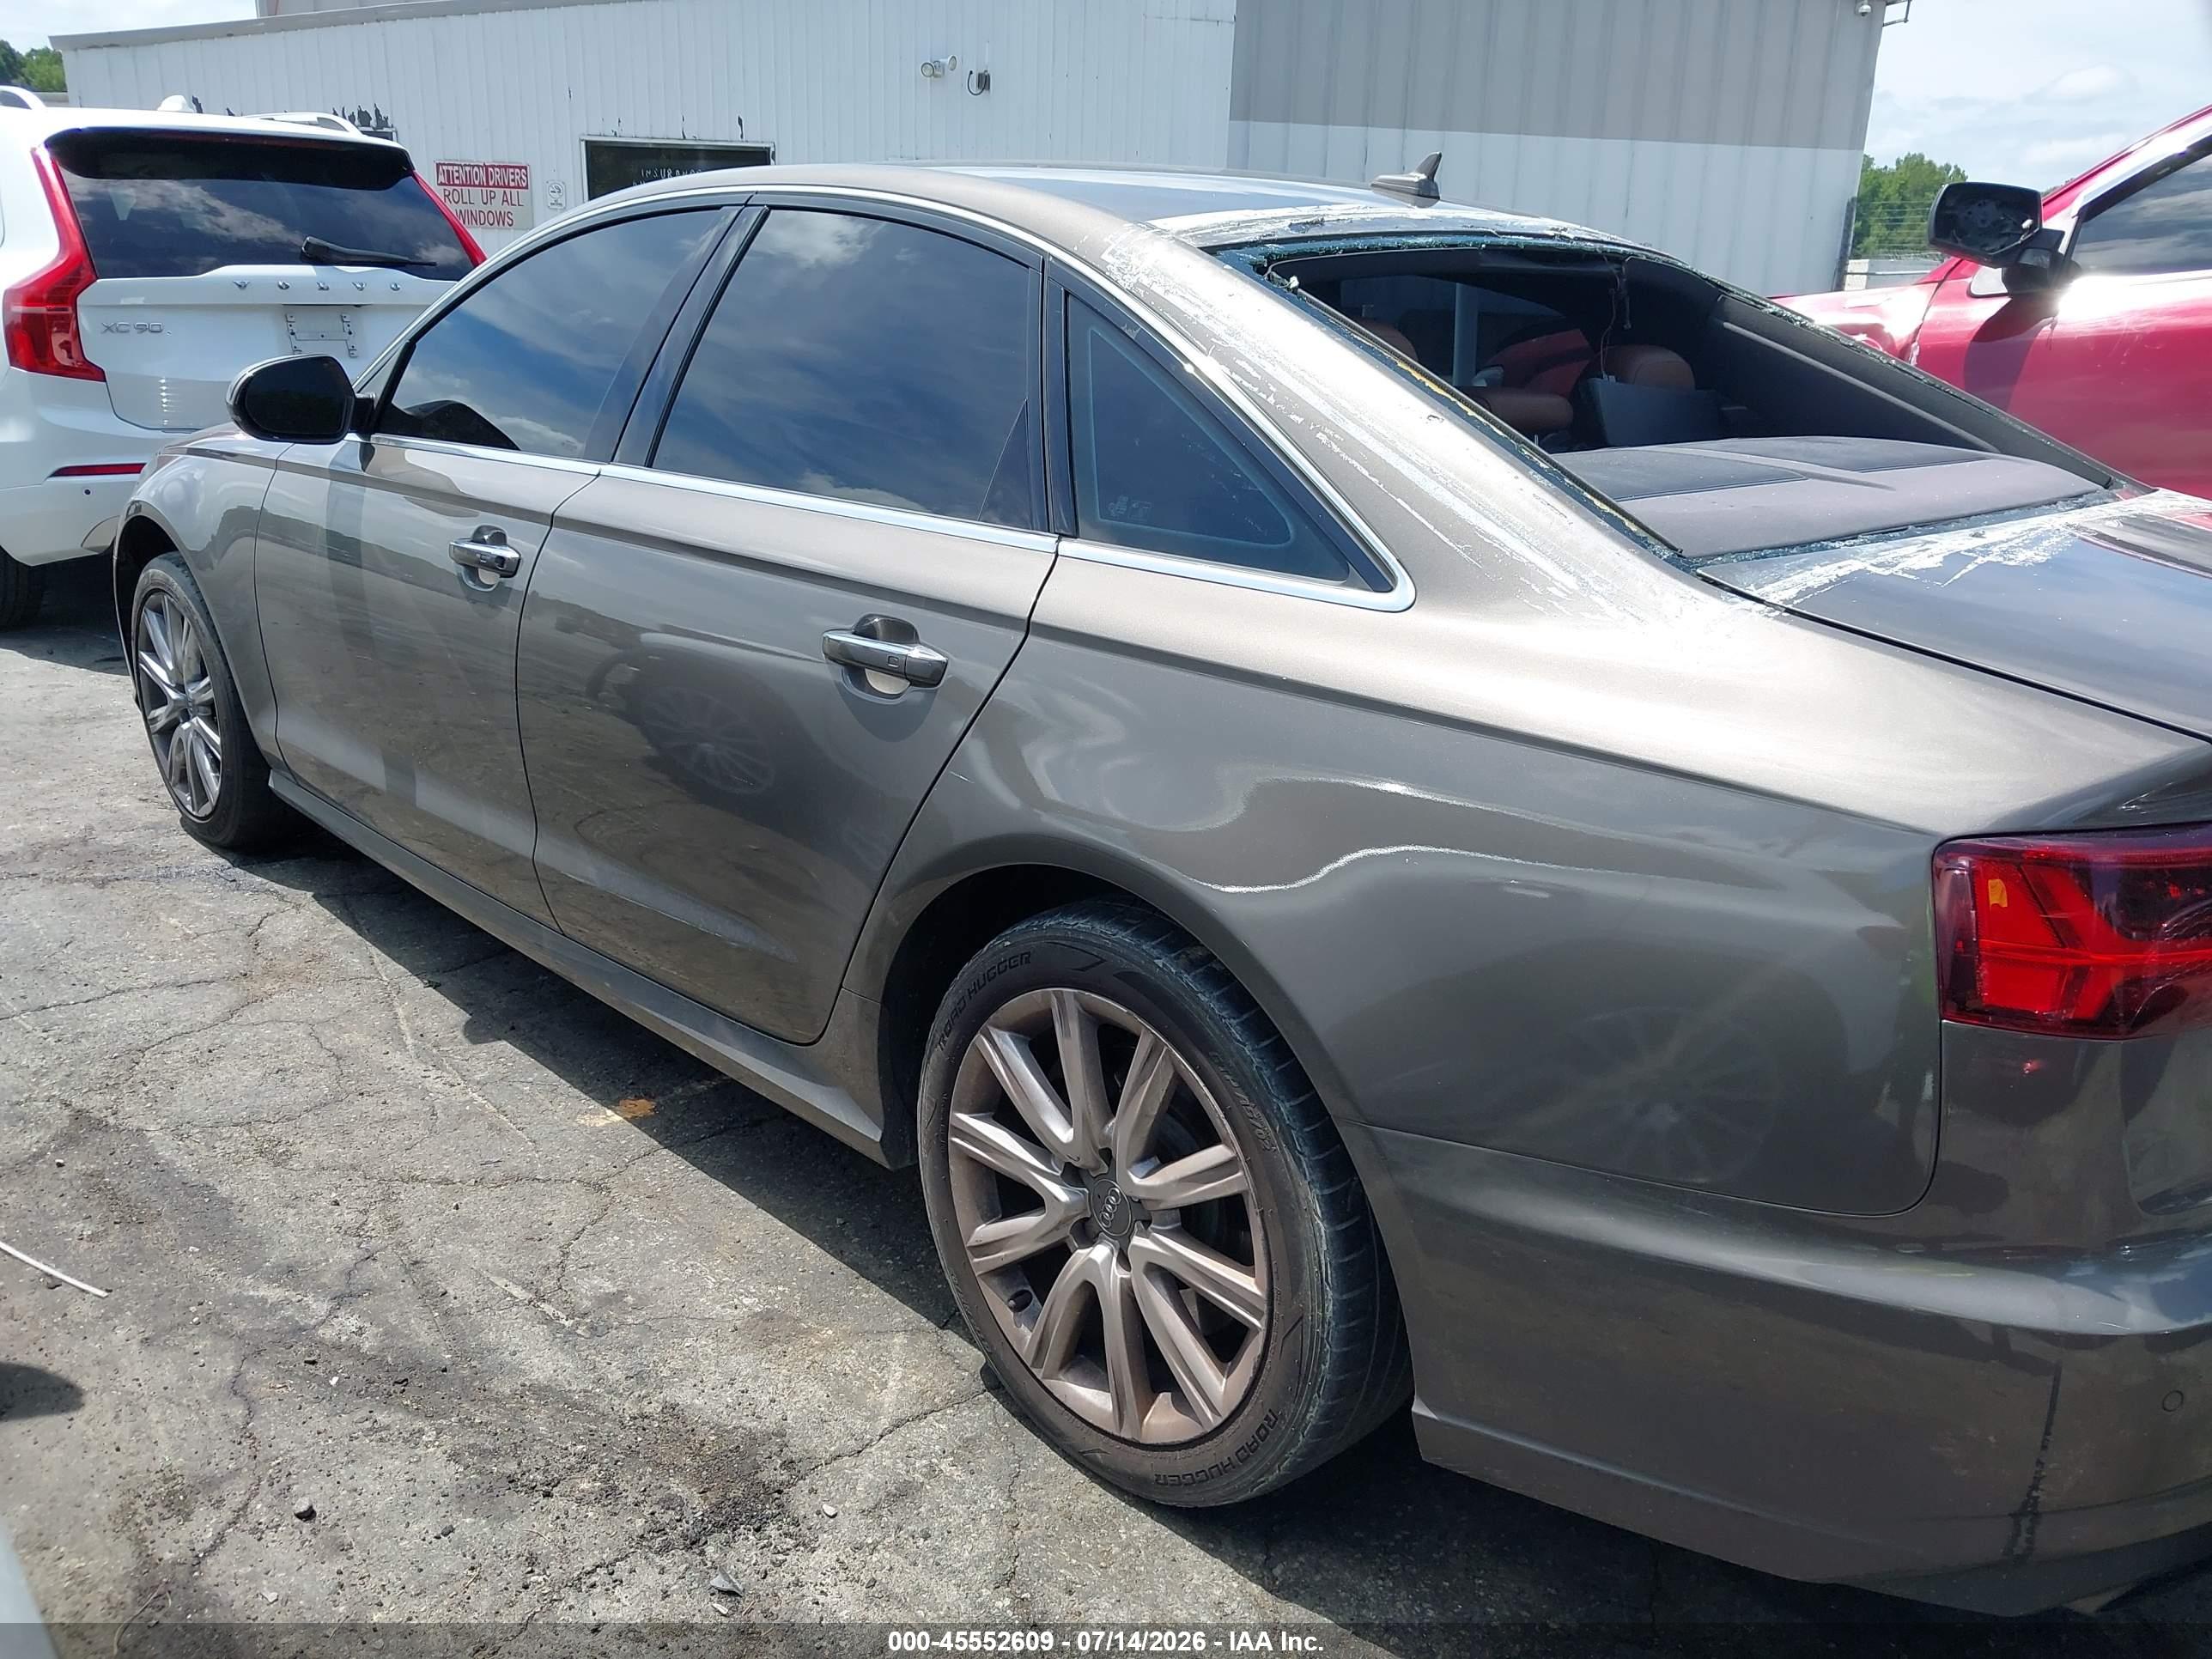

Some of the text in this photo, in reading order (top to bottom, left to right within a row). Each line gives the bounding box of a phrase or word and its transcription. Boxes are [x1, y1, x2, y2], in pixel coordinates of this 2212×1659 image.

[438, 165, 527, 187] ATTENTION DRIVERS
[443, 188, 524, 207] ROLL UP ALL
[455, 210, 514, 227] WINDOWS
[233, 280, 401, 292] VOLVO
[938, 951, 1031, 1052] ROAD HUGGER
[1234, 1407, 1279, 1465] ROAD
[1154, 1456, 1237, 1486] HUGGER
